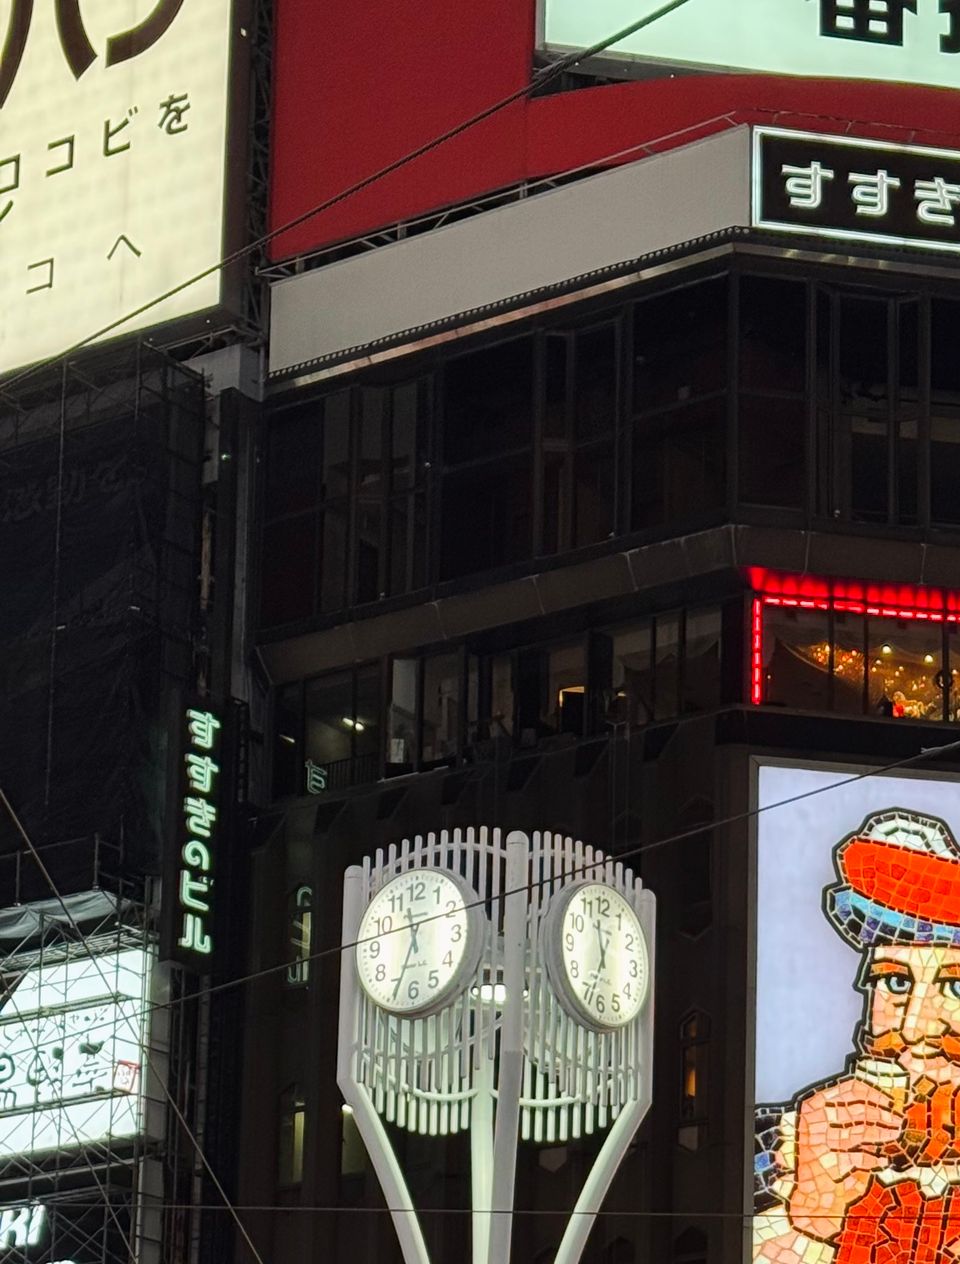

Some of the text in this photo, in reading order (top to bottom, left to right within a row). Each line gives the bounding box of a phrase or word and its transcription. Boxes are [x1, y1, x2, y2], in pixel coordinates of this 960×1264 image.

[178, 708, 222, 954] すすきのビル
[406, 882, 426, 902] 12
[433, 886, 441, 904] 1
[388, 893, 403, 913] 11
[445, 900, 457, 918] 2
[581, 898, 592, 918] 11
[595, 896, 610, 918] 12
[374, 916, 392, 937] 10
[570, 913, 584, 933] 10
[615, 913, 622, 931] 1
[451, 924, 462, 942] 3
[565, 933, 574, 952] 9
[625, 933, 634, 952] 2
[369, 941, 380, 959] 9
[442, 950, 453, 968] 4
[375, 964, 386, 982] 8
[570, 960, 579, 978] 8
[629, 959, 638, 978] 3
[428, 969, 439, 989] 5
[391, 978, 401, 1000] 7
[408, 980, 419, 1000] 6
[582, 982, 591, 1000] 7
[623, 983, 632, 1000] 4
[596, 995, 605, 1014] 6
[611, 993, 621, 1012] 5
